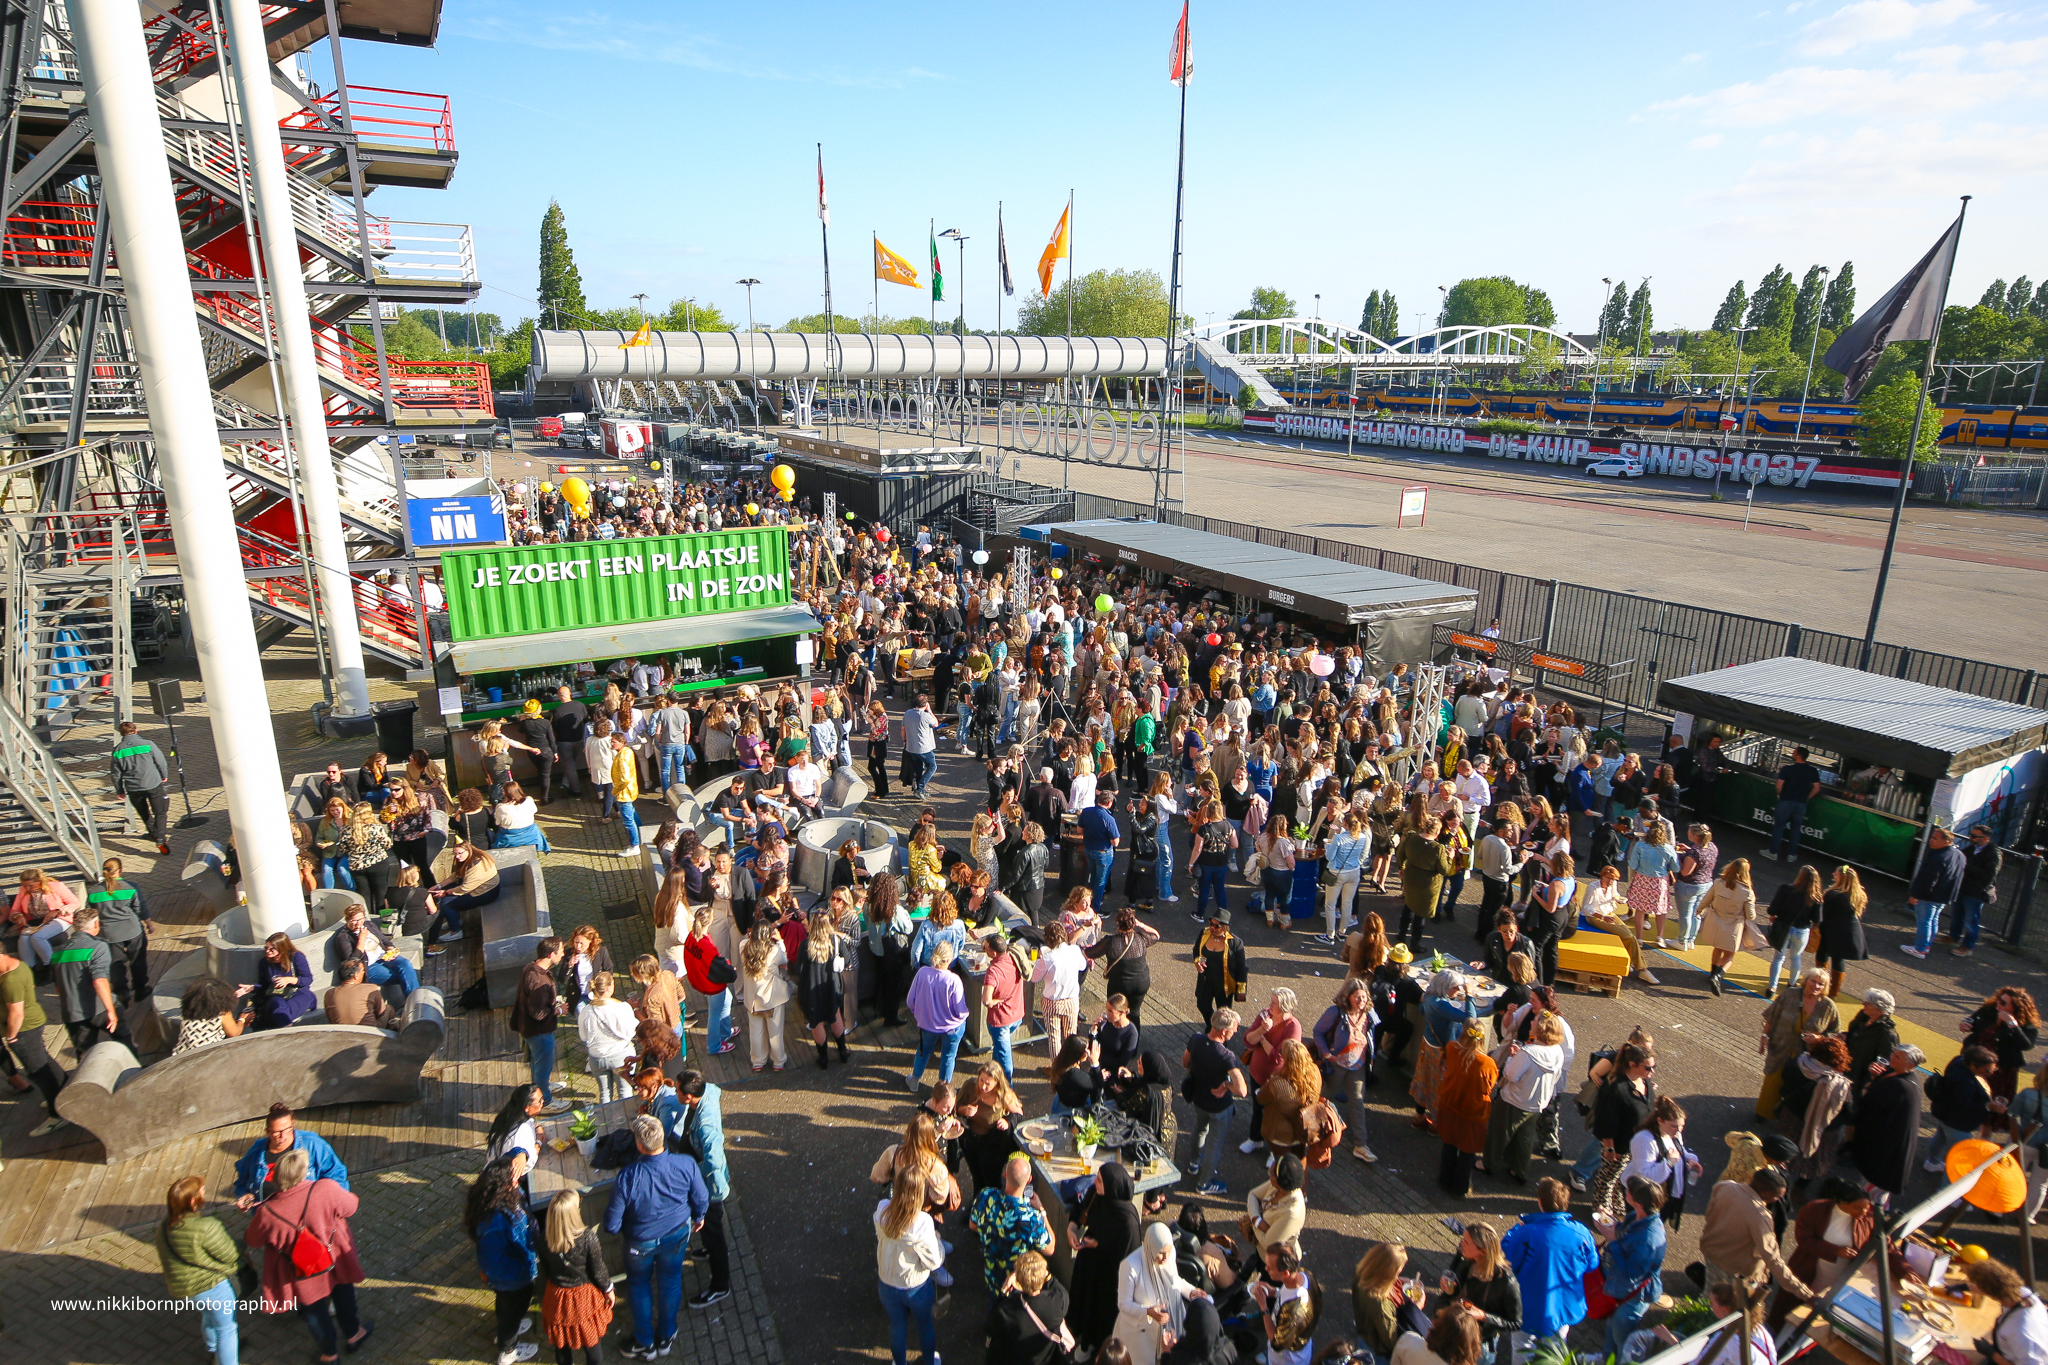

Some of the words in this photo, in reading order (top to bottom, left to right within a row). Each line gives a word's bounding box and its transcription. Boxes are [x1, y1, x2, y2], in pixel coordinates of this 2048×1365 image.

[1274, 413, 1344, 441] STADION
[1348, 420, 1466, 453] FEIJENOORD
[1488, 432, 1520, 459] DE
[1525, 434, 1590, 465] KUIP
[1619, 442, 1718, 478] SINDS
[1728, 451, 1821, 488] 1937
[430, 513, 477, 541] NN
[1118, 549, 1138, 562] SNACKS
[473, 567, 501, 589] JE
[508, 560, 591, 584] ZOEKT
[599, 555, 643, 577] EEN
[651, 545, 759, 572] PLAATSJE
[666, 582, 694, 602] IN
[701, 578, 730, 598] DE
[735, 573, 783, 595] ZON
[1268, 589, 1295, 605] BURGERS
[1462, 638, 1485, 648] LOEMPIA
[1545, 659, 1570, 670] LOEMPIA
